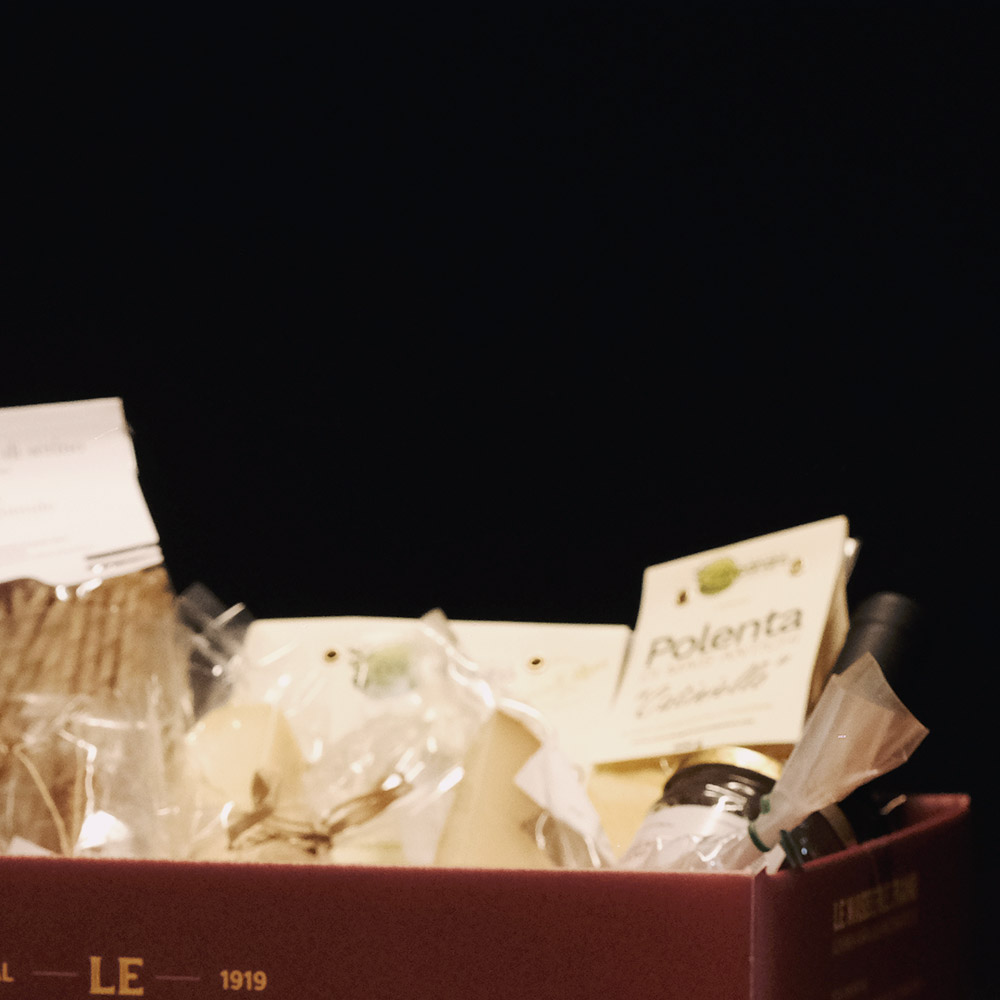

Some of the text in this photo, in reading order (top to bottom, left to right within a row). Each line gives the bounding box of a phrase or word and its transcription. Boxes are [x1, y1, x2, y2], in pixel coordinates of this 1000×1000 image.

[646, 607, 803, 667] Polenta
[89, 955, 144, 997] LE
[219, 968, 267, 991] 1919
